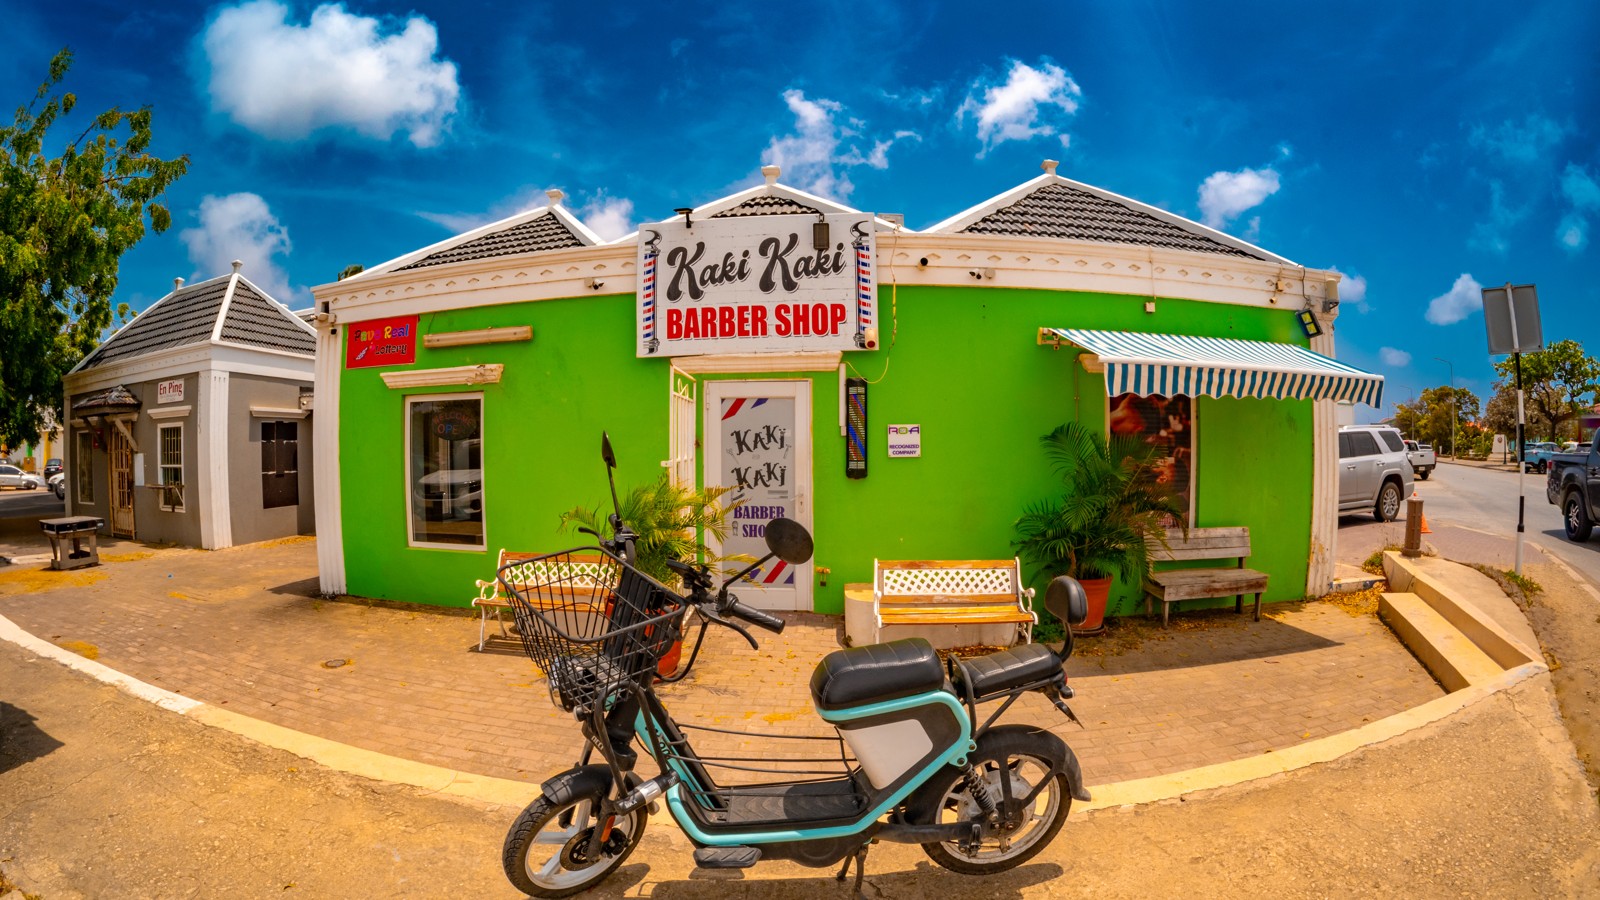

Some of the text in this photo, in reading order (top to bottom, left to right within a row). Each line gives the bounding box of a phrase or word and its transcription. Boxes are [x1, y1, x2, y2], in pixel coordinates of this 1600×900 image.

[666, 232, 847, 303] Kaki Kaki
[666, 303, 848, 341] BARBER SHOP
[354, 324, 409, 341] Pavo Real
[375, 345, 407, 355] Lottery
[160, 381, 182, 396] En Ping
[733, 505, 785, 520] BARBER
[742, 524, 766, 538] SHO
